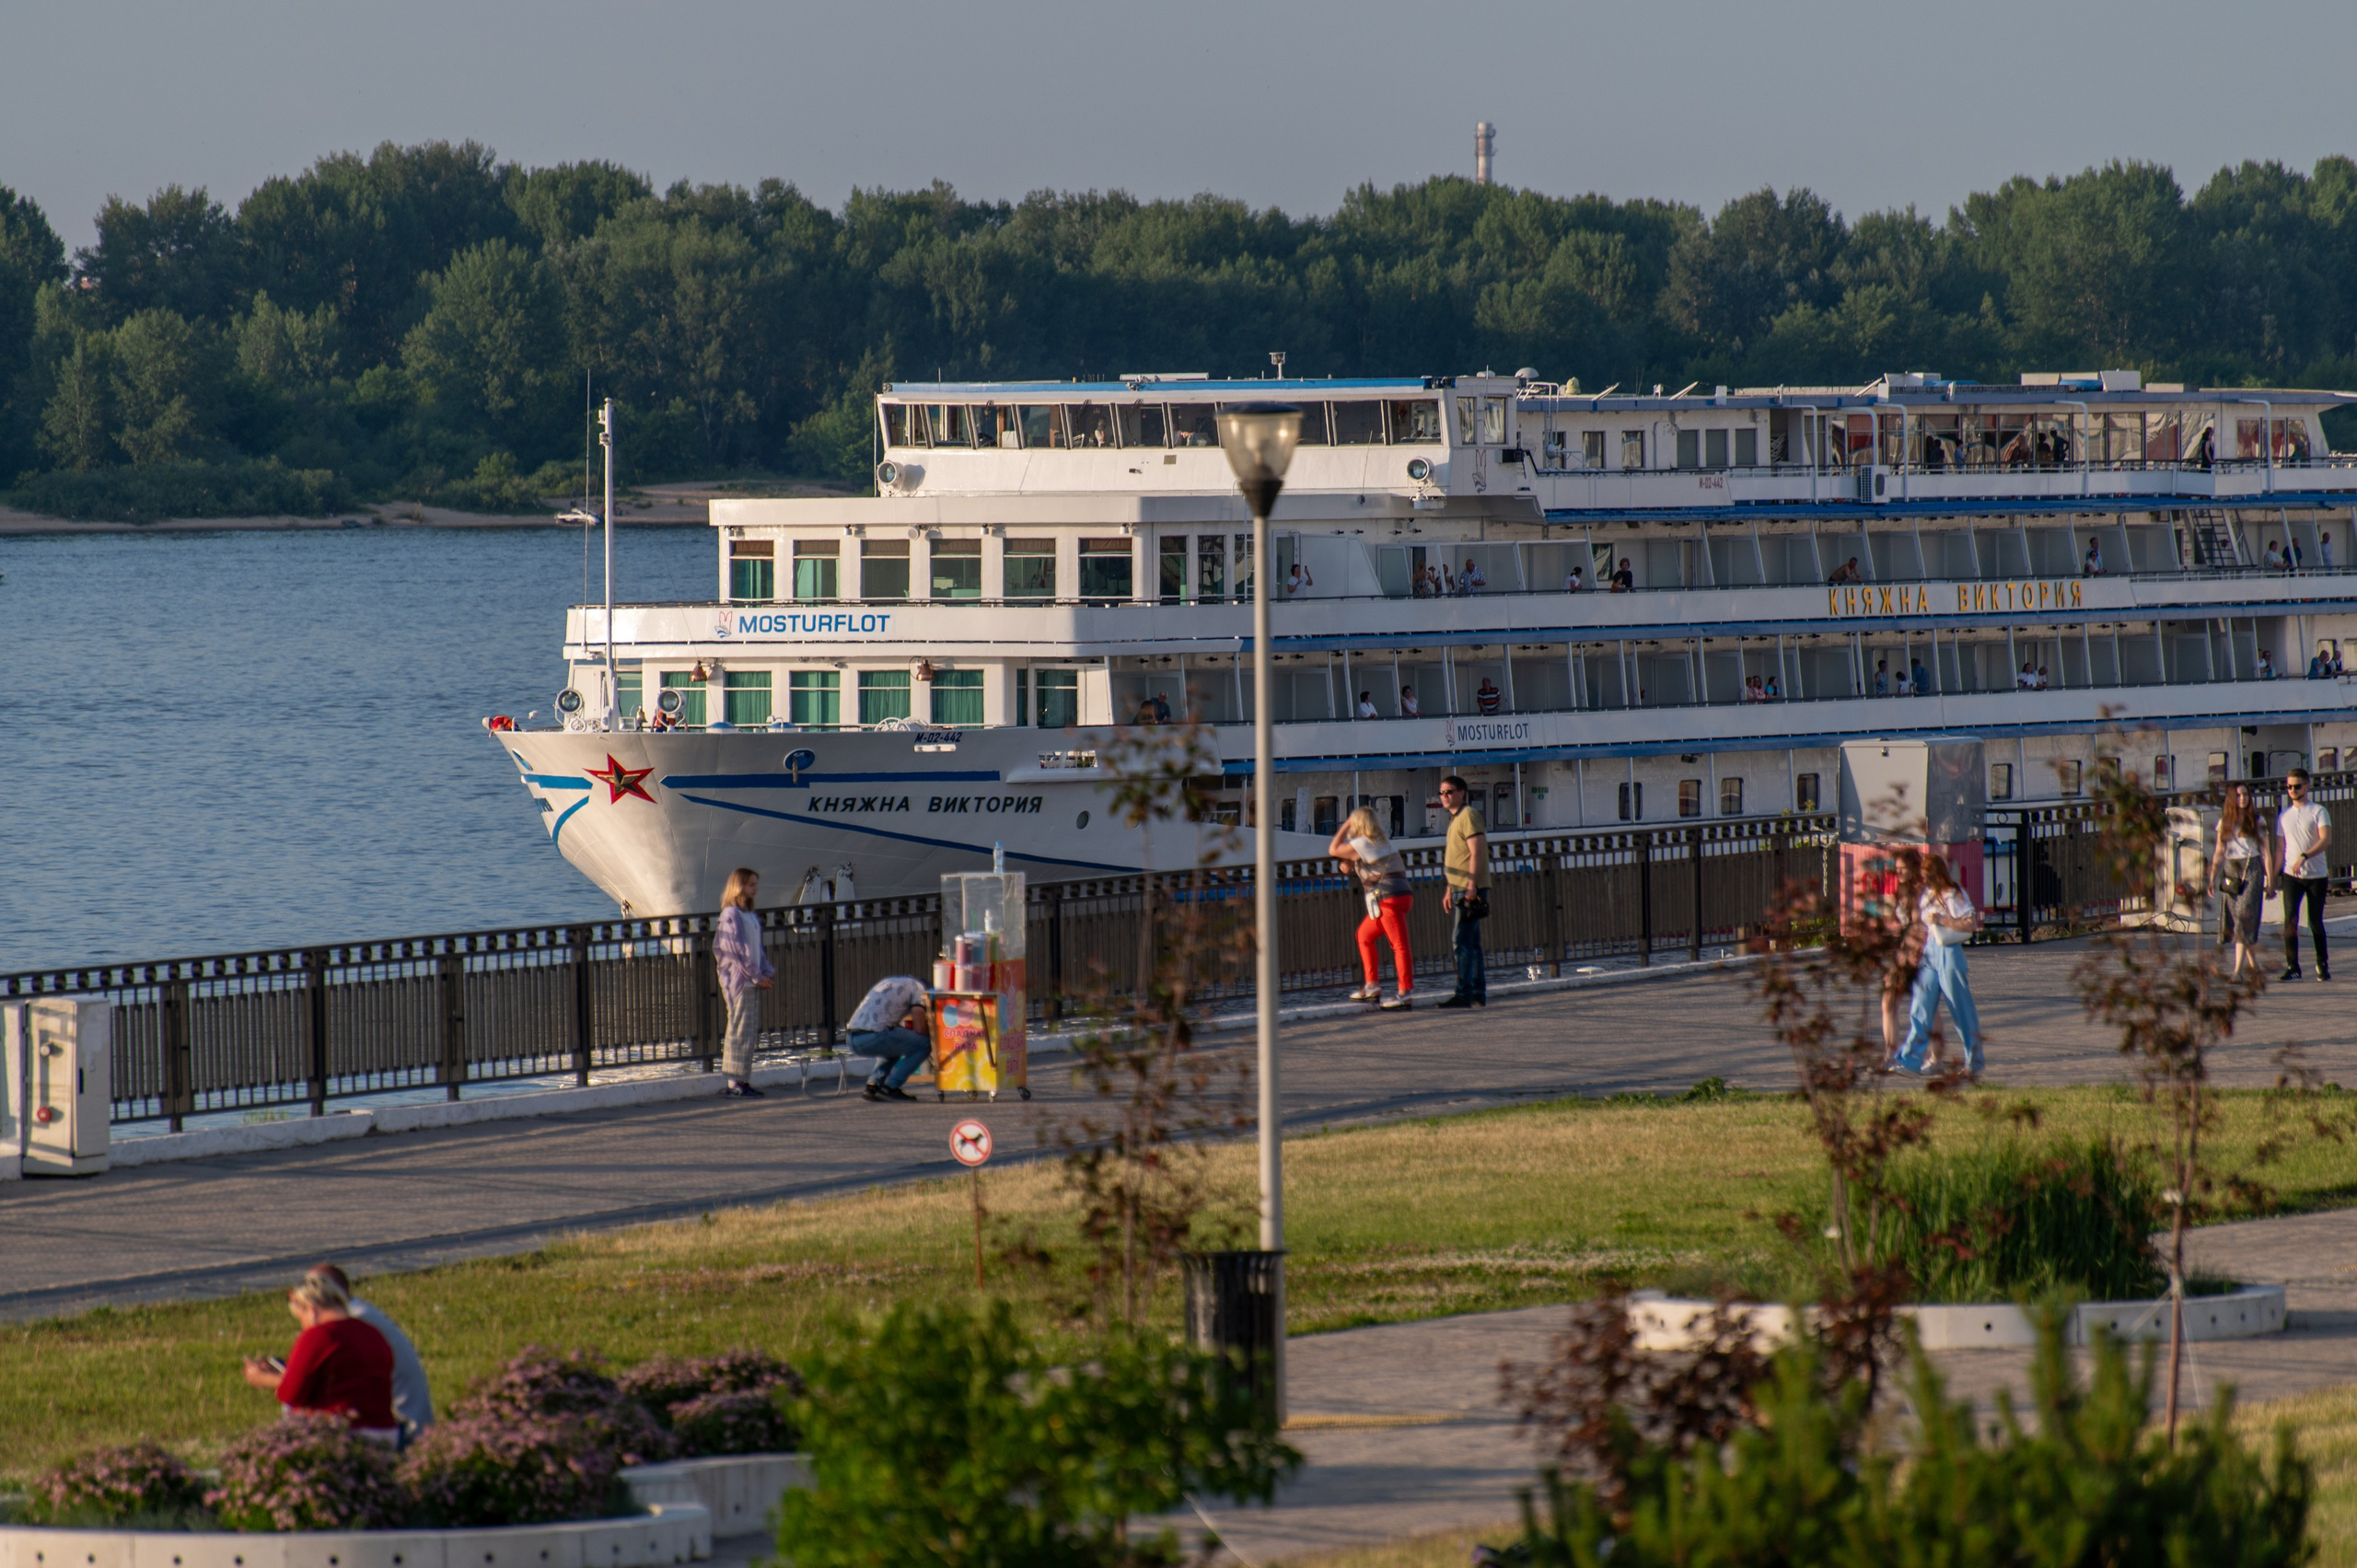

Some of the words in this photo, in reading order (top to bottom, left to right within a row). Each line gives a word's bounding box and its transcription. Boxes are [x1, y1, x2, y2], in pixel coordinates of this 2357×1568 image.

[1829, 586, 1930, 615] КНЯЖНА
[1957, 581, 2083, 611] ВИКТОРИЯ
[739, 614, 890, 633] MOSTURFLOT
[1457, 723, 1528, 741] MOSTURFLOT
[807, 796, 911, 812] КНЯЖНА
[927, 796, 1043, 813] ВИКТОРИЯ
